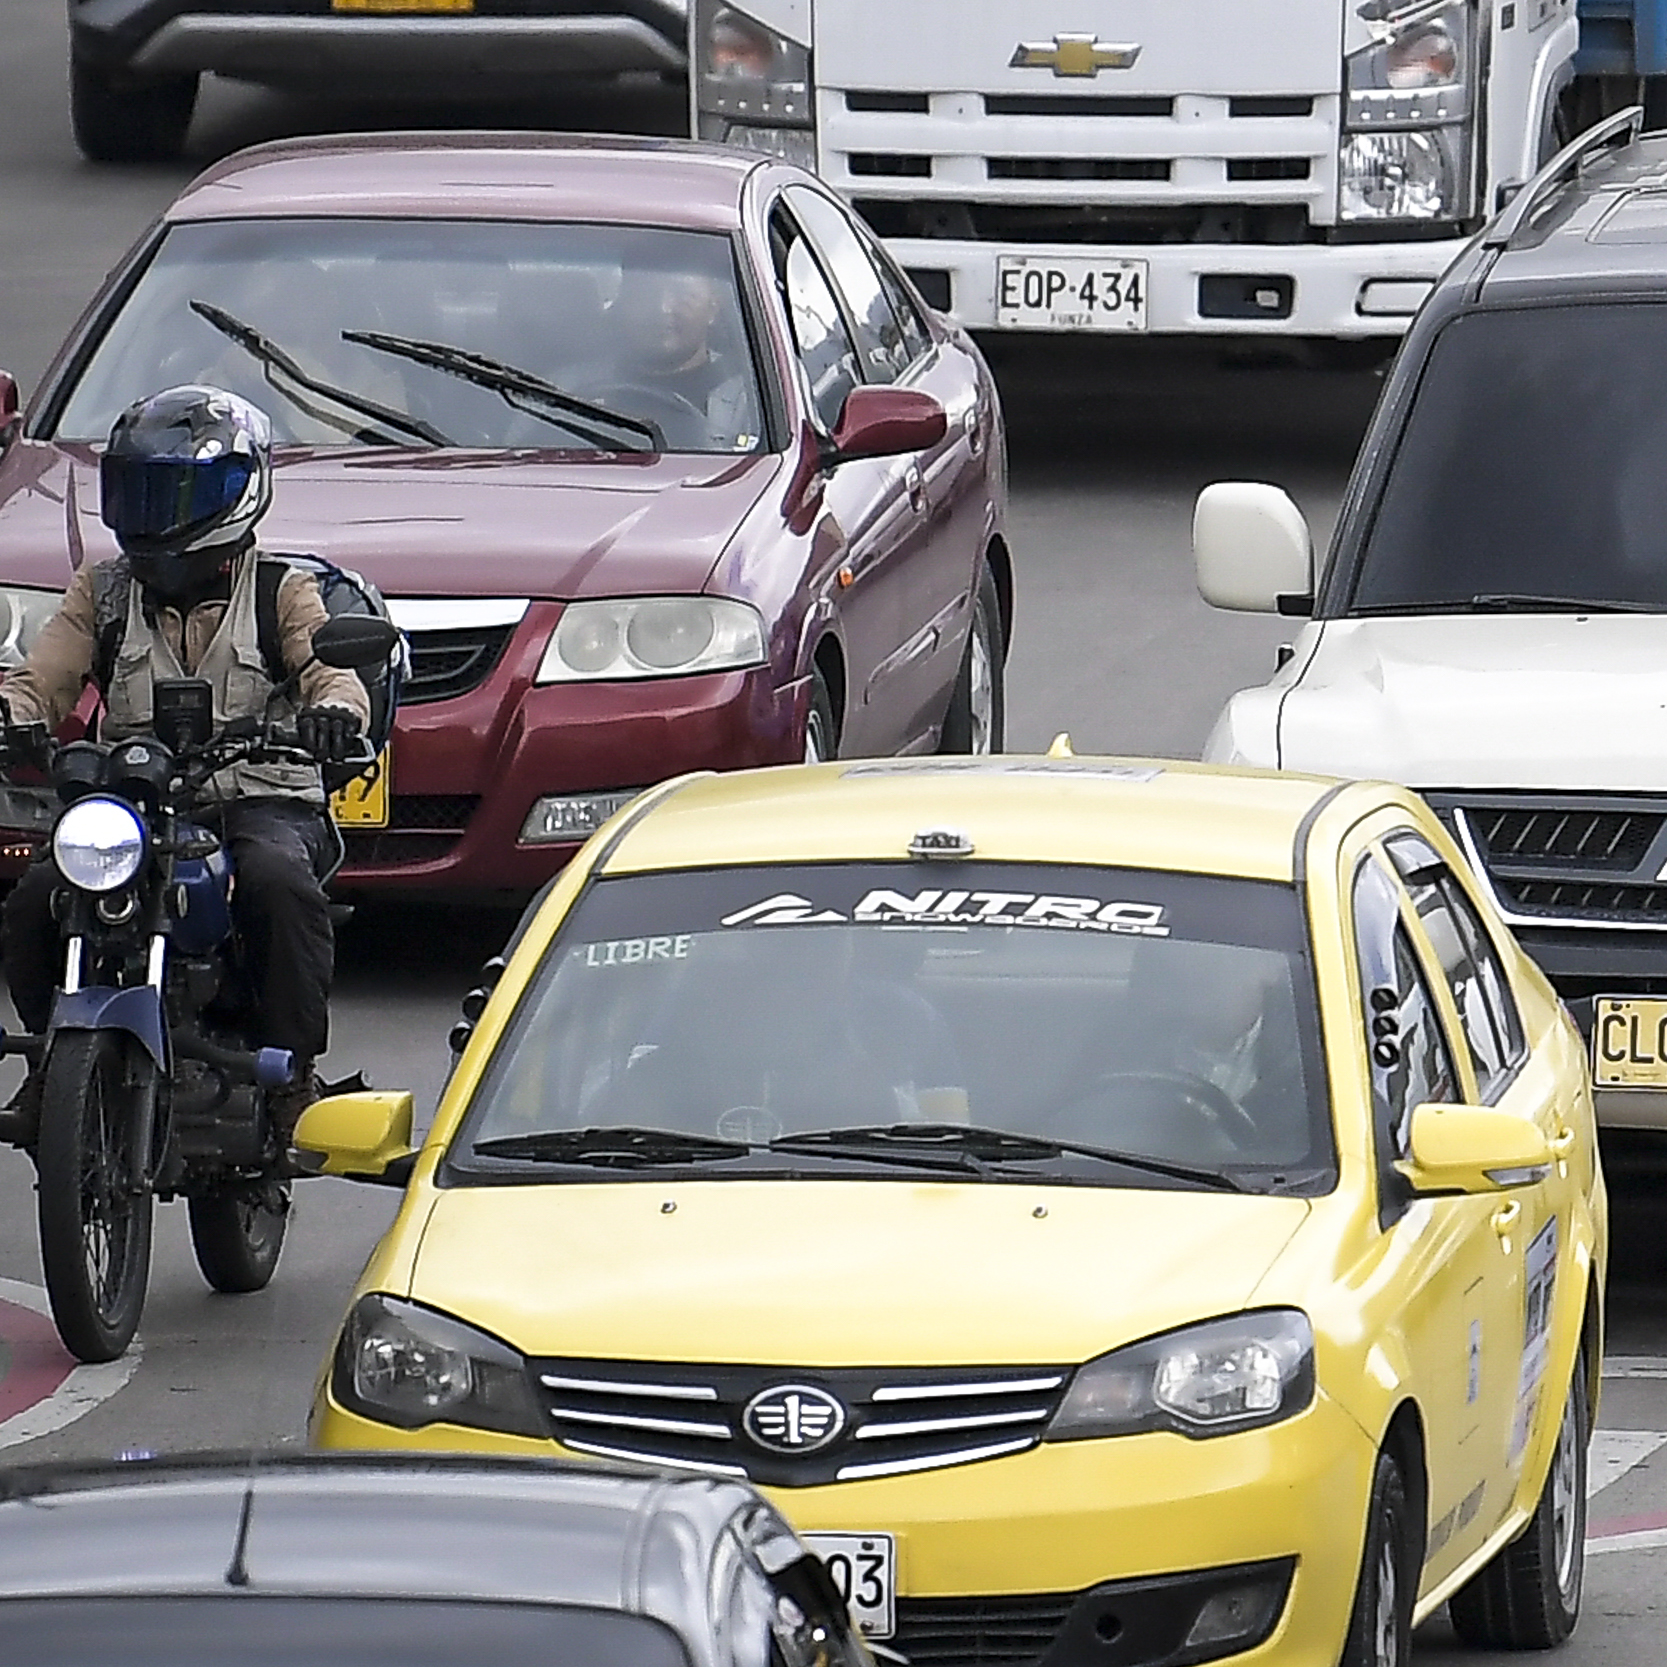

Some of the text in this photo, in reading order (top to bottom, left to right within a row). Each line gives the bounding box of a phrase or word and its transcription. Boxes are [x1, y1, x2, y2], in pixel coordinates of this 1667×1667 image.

[916, 834, 961, 849] TAXI
[854, 889, 1166, 926] NITRO
[586, 934, 692, 967] LIBRE
